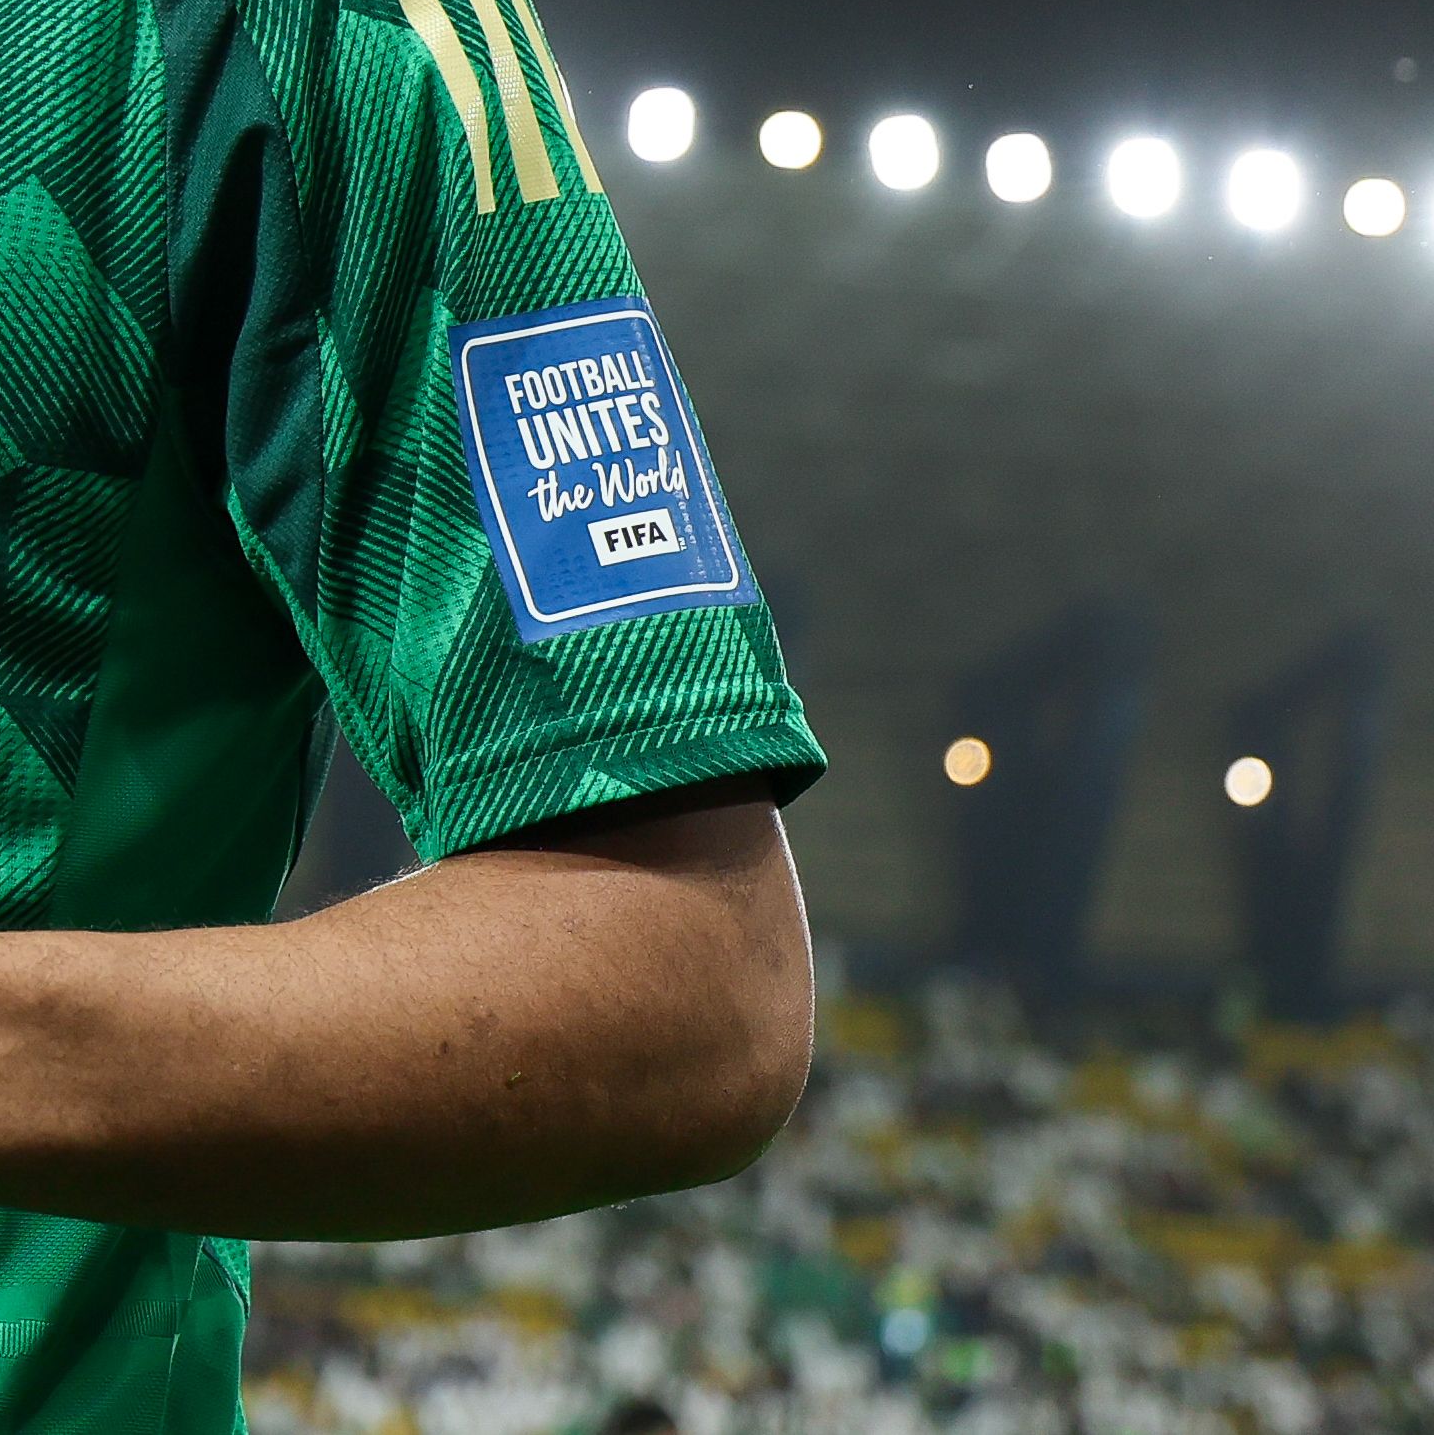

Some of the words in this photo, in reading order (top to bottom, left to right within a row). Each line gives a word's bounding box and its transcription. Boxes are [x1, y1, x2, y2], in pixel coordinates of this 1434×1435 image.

[504, 350, 655, 414] FOOTBALL
[516, 392, 670, 469] UNITES
[527, 470, 594, 522] the
[592, 447, 689, 507] World
[604, 521, 667, 553] FIFA
